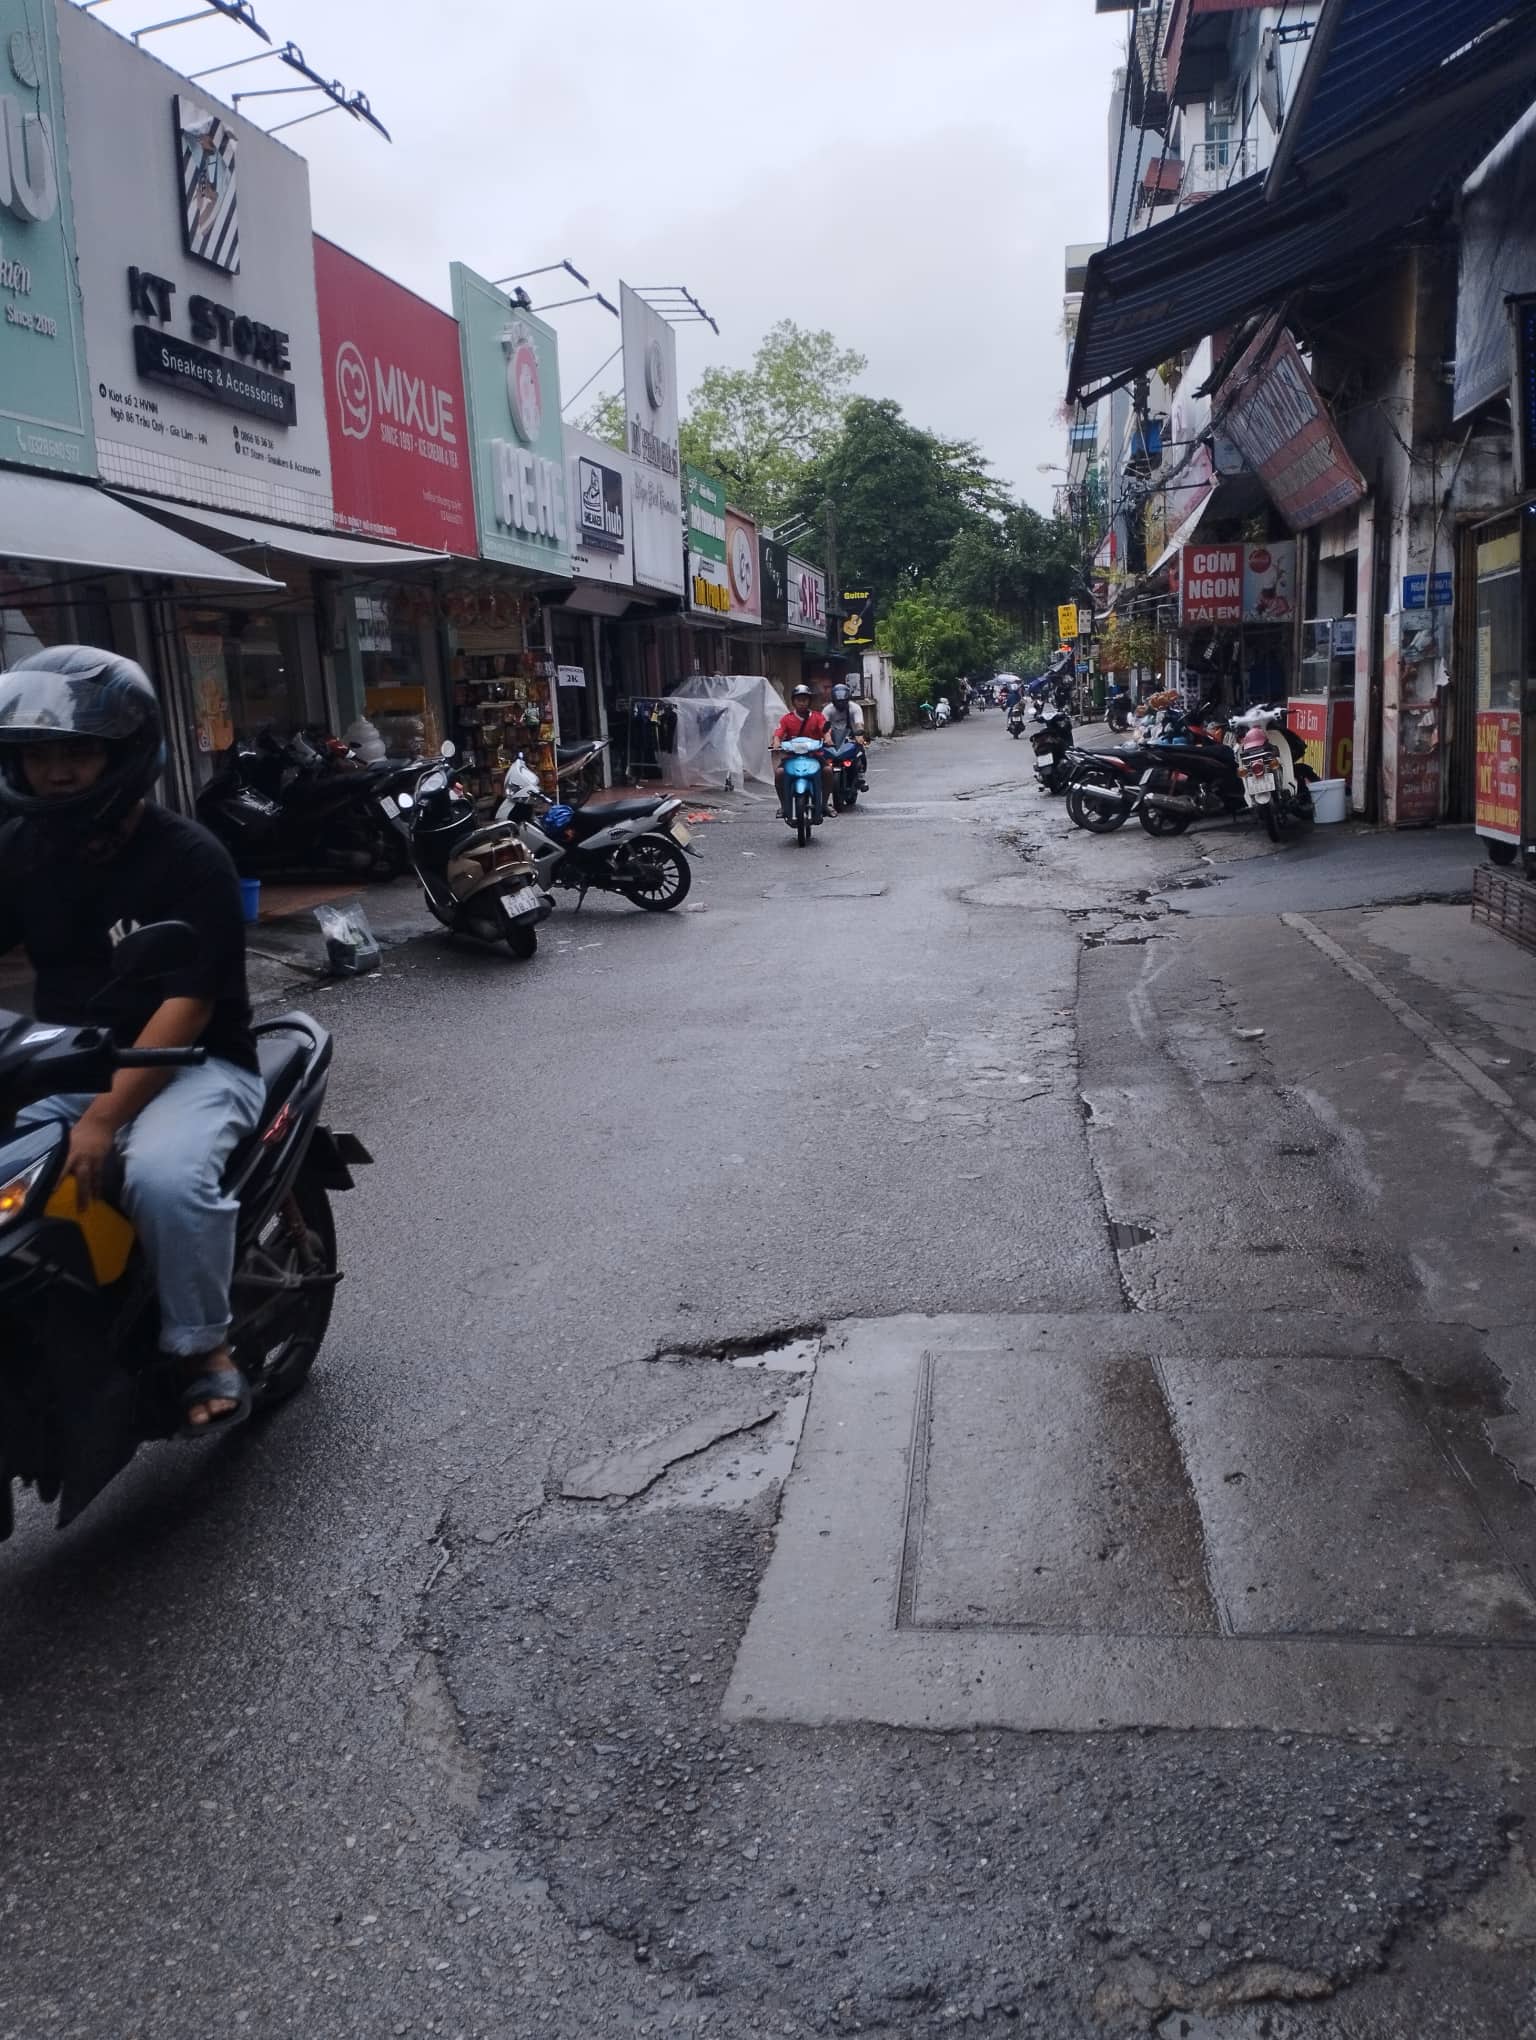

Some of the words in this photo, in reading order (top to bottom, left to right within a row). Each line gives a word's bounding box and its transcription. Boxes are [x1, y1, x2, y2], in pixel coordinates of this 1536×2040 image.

[5, 303, 33, 328] Since
[129, 266, 176, 322] KT
[189, 294, 292, 371] STORE
[162, 348, 213, 383] Sneakers
[216, 369, 224, 387] &
[226, 372, 284, 409] Accessories
[374, 356, 457, 444] MIXUE
[380, 422, 399, 447] SINCE
[605, 501, 622, 536] hub
[1193, 550, 1236, 575] CƠM
[801, 573, 819, 620] SHE
[843, 591, 870, 600] Guitar
[1188, 578, 1240, 599] NGON
[1217, 606, 1240, 619] EM
[1308, 710, 1318, 731] Em
